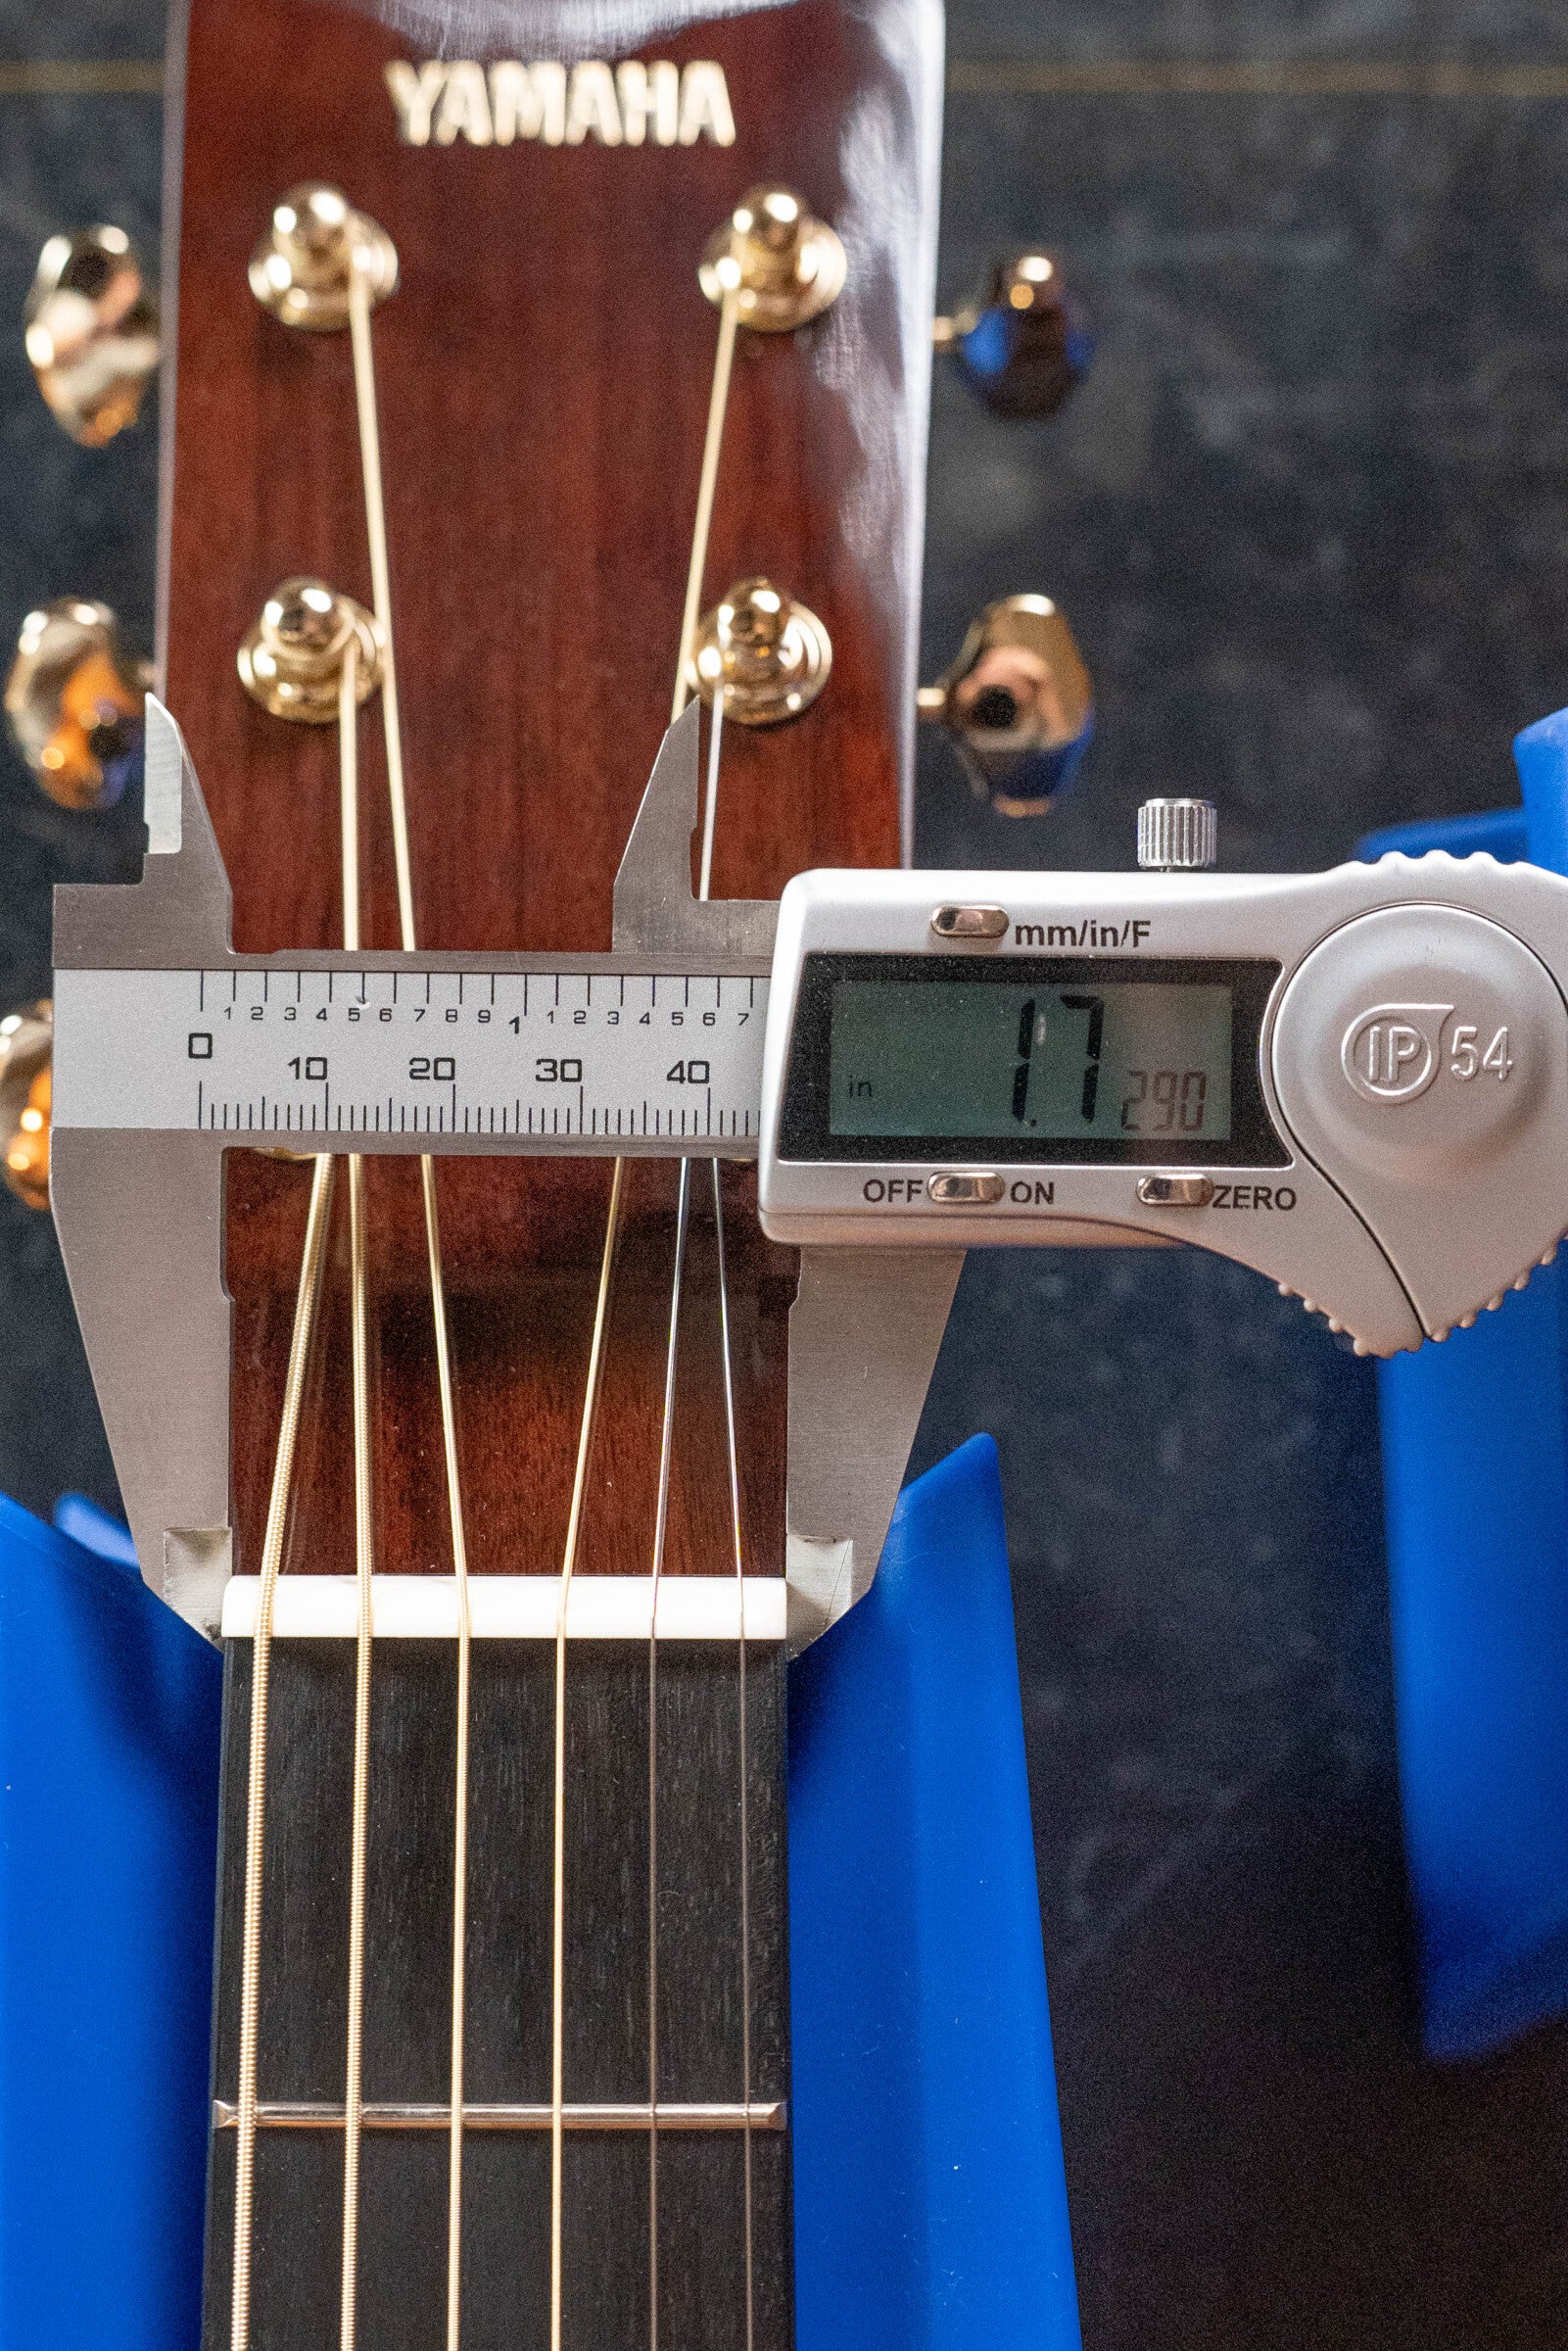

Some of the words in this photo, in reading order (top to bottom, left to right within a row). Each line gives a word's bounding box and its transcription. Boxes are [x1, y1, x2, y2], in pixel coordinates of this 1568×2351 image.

[382, 59, 736, 147] YAMAHA
[1014, 919, 1152, 948] mm/in/F
[223, 1007, 232, 1021] 1
[250, 1006, 264, 1021] 2
[284, 1007, 297, 1021] 3
[315, 1007, 328, 1022] 4
[348, 1007, 360, 1022] 5
[379, 1008, 393, 1023] 6
[413, 1008, 426, 1023] 7
[445, 1008, 458, 1023] 8
[477, 1009, 491, 1024] 9
[508, 1016, 520, 1034] 1
[546, 1010, 554, 1025] 1
[573, 1010, 587, 1025] 2
[607, 1011, 620, 1026] 3
[639, 1011, 651, 1026] 4
[671, 1011, 685, 1026] 5
[702, 1012, 716, 1027] 6
[736, 1013, 750, 1027] 7
[187, 1032, 214, 1059] 0
[287, 1056, 328, 1080] 10
[408, 1056, 455, 1081] 20
[535, 1058, 583, 1082] 30
[666, 1060, 710, 1083] 40
[1368, 1026, 1421, 1083] IP
[1449, 1026, 1514, 1082] 54
[848, 1075, 873, 1097] in
[863, 1178, 924, 1203] OFF
[1010, 1180, 1056, 1205] ON
[1212, 1184, 1298, 1212] ZERO
